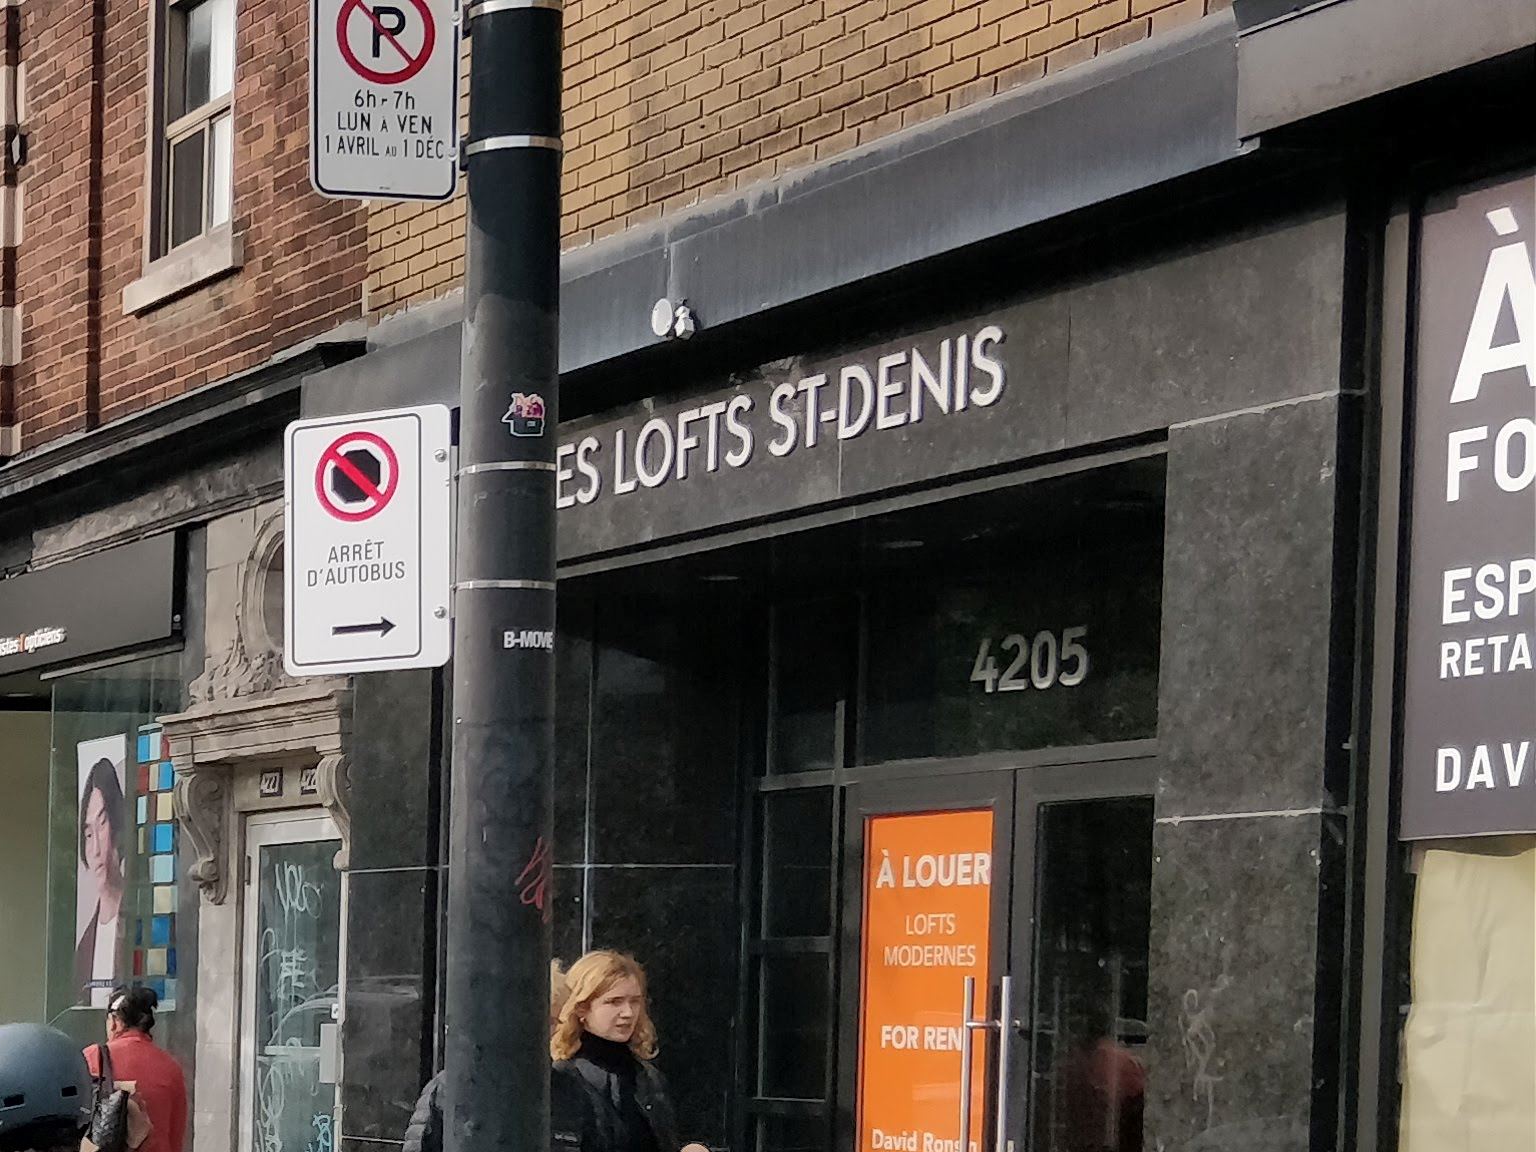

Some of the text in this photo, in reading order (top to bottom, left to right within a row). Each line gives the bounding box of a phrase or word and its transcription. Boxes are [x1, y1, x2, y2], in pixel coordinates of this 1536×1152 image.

[337, 111, 371, 132] LUN
[397, 115, 432, 134] VEN
[325, 135, 444, 159] 1 AVRIL AU 1 DÉC
[1450, 206, 1536, 404] À
[614, 393, 755, 495] LOFTS
[767, 325, 1007, 457] ST-DENIS
[1446, 418, 1536, 502] FO
[328, 539, 385, 564] ARRÊT
[307, 561, 406, 588] D'AUTOBUS
[970, 626, 1089, 694] 4205
[1440, 633, 1533, 680] RETA
[1435, 741, 1536, 792] DAV
[876, 849, 992, 888] À LOUER
[905, 913, 956, 936] LOFTS
[884, 945, 977, 967] MODERNES
[881, 1024, 919, 1050] FOR
[872, 1129, 918, 1152] David
